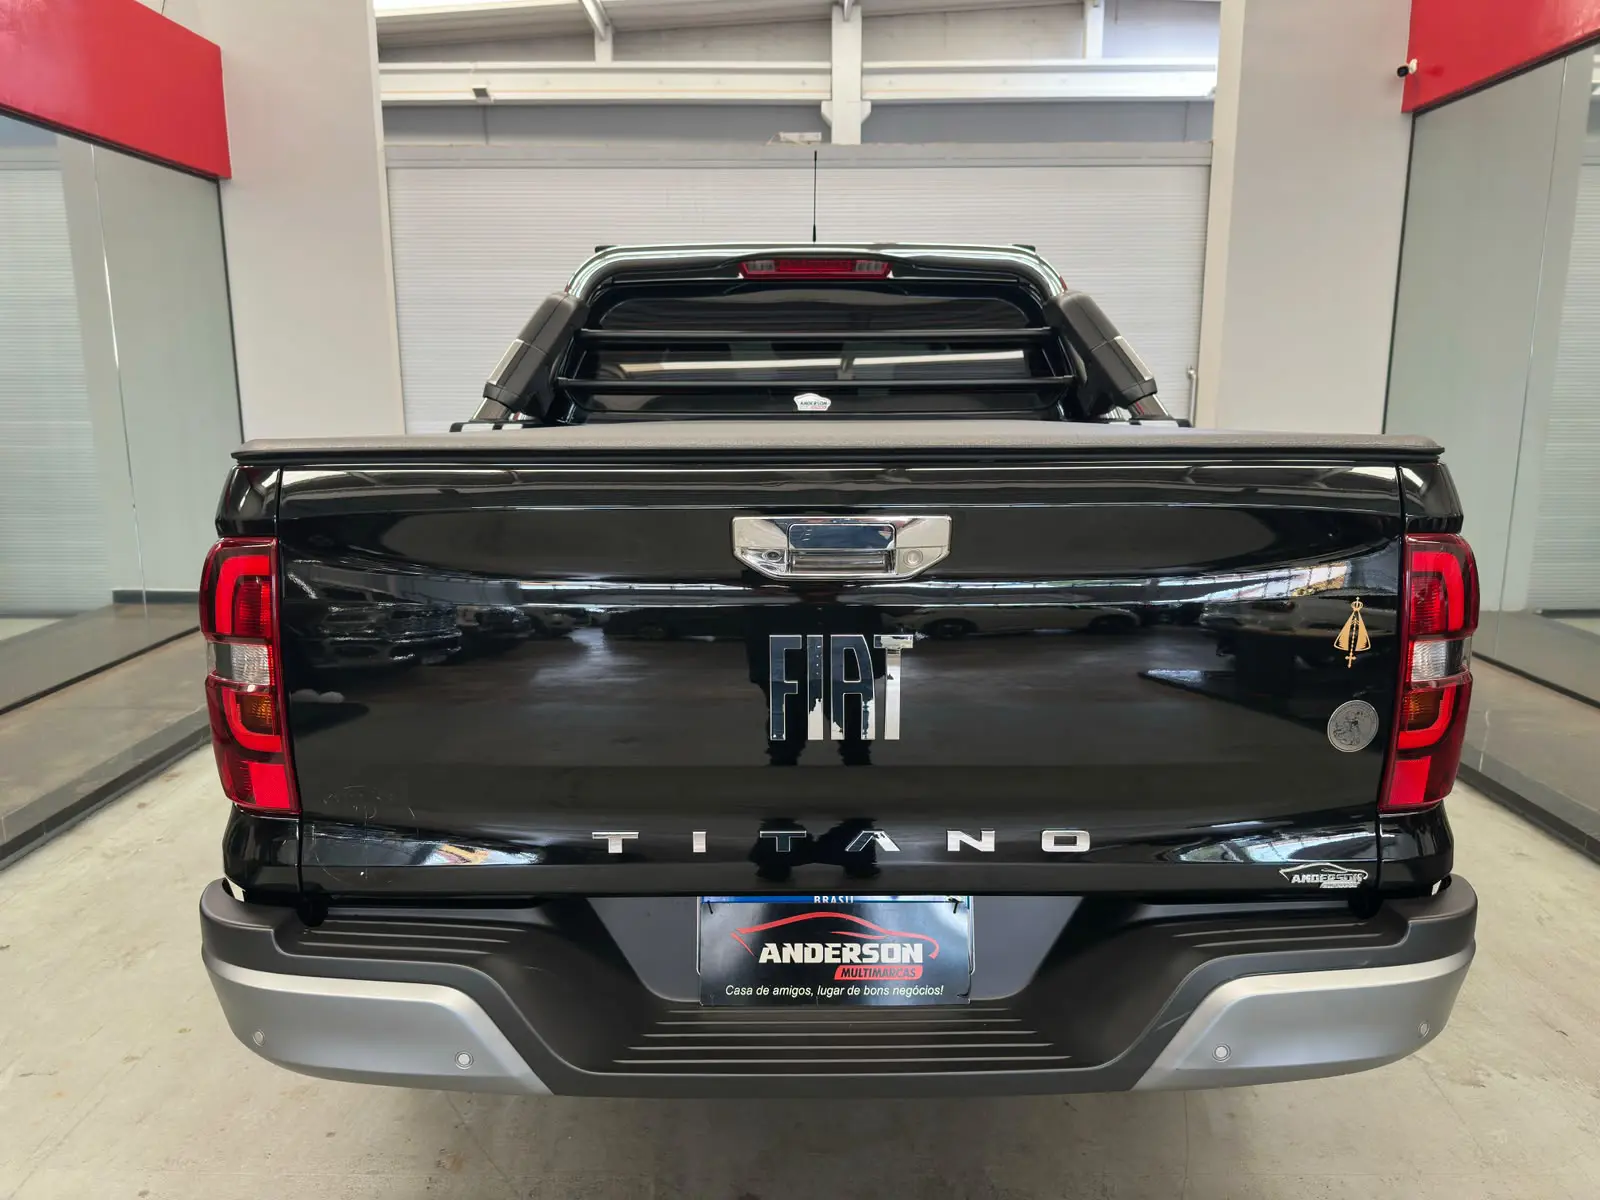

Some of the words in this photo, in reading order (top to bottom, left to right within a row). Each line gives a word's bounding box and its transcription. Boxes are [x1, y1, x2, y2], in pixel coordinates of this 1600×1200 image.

[769, 634, 914, 741] FIAT
[591, 830, 1091, 854] TITANO
[1291, 873, 1363, 884] ANDERSON
[758, 942, 924, 964] ANDERSON
[840, 967, 916, 978] MULTIMARCAS
[725, 984, 754, 996] Casa
[755, 984, 770, 996] de
[772, 985, 814, 999] amigos,
[816, 985, 845, 998] lugar
[846, 985, 861, 996] de
[863, 985, 890, 996] bons
[892, 984, 945, 998] negócios!
